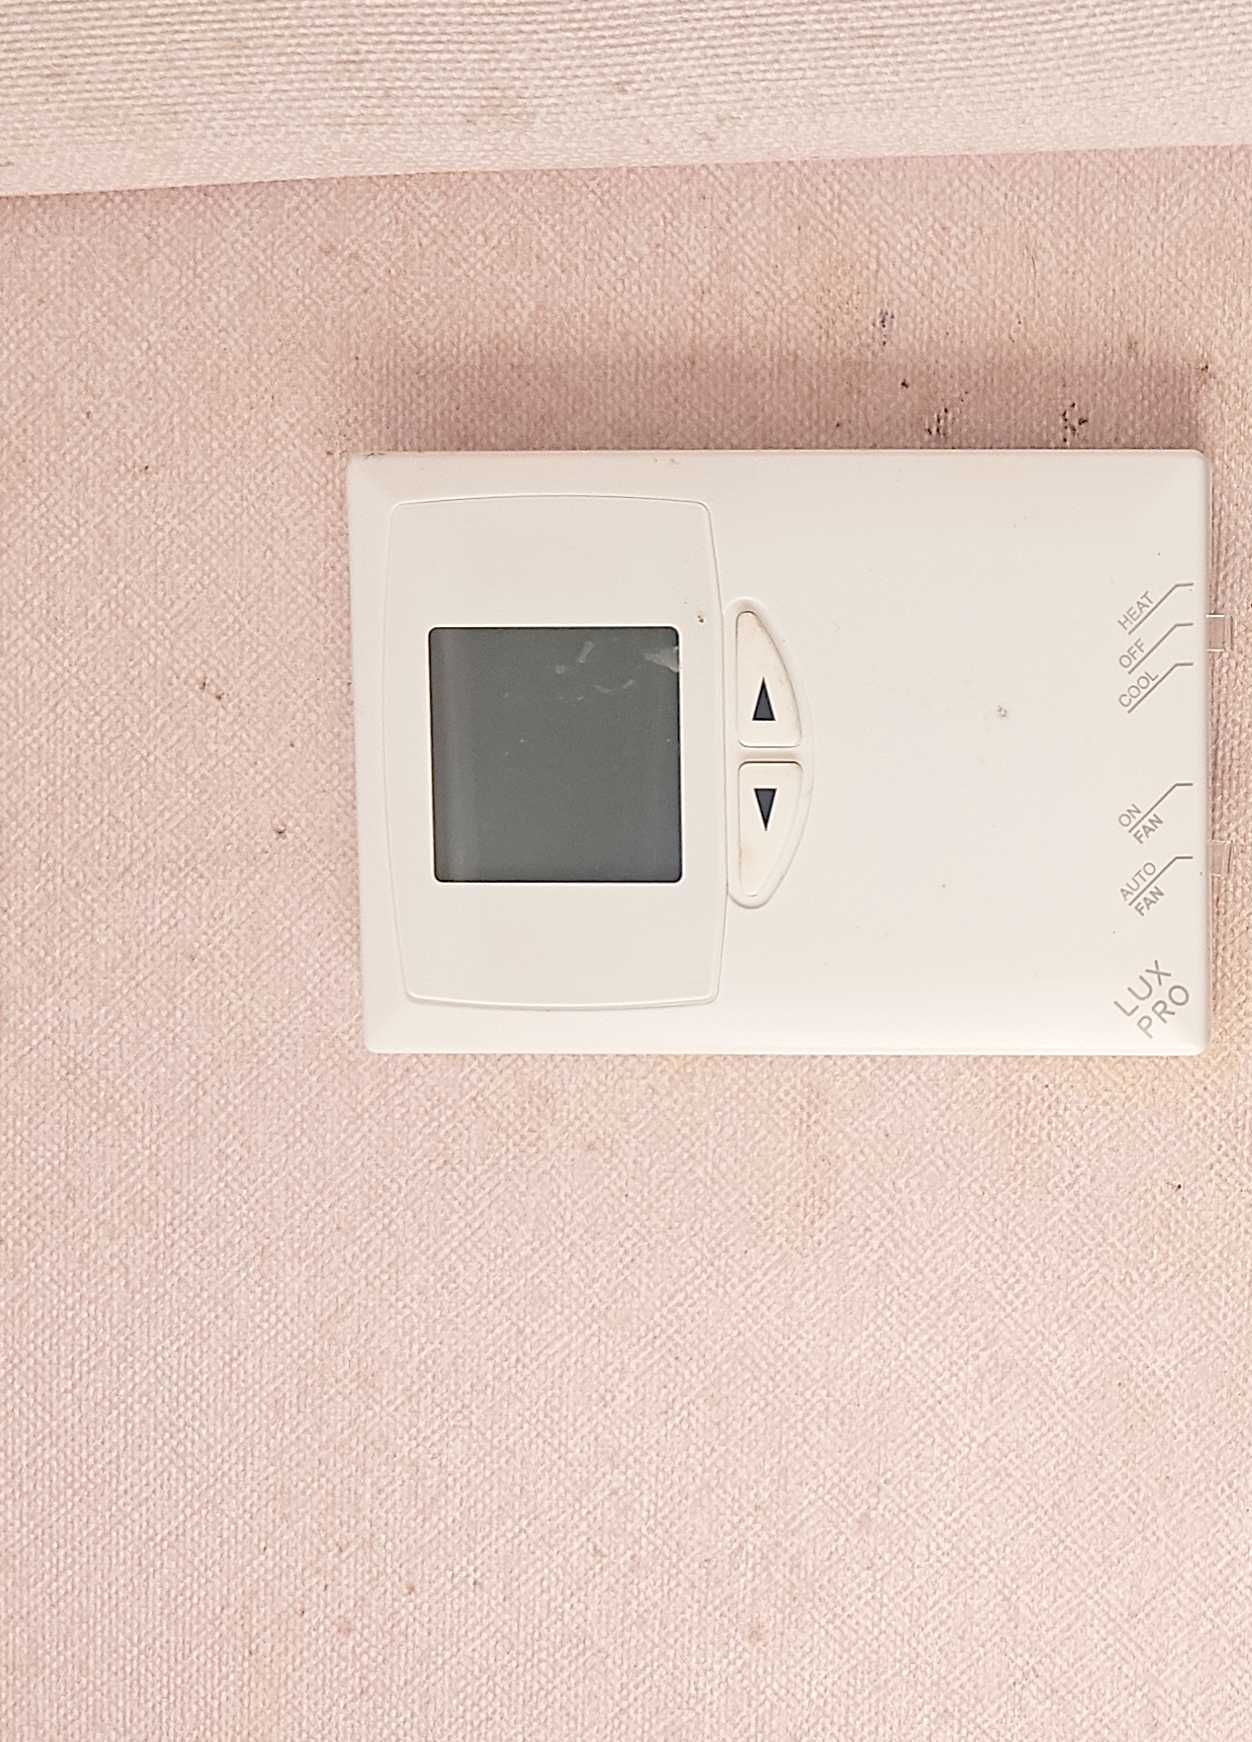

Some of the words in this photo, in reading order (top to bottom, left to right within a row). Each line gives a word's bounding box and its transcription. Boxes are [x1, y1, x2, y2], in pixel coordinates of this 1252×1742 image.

[1117, 590, 1154, 631] HEAT
[1118, 638, 1146, 669] OFF
[1118, 671, 1159, 708] COOL
[1118, 803, 1143, 828] ON
[1132, 813, 1164, 844] FAN
[1119, 862, 1157, 901] AUTO
[1134, 885, 1165, 916] FAN
[1113, 959, 1172, 1017] LUX
[1136, 984, 1190, 1039] PRO
